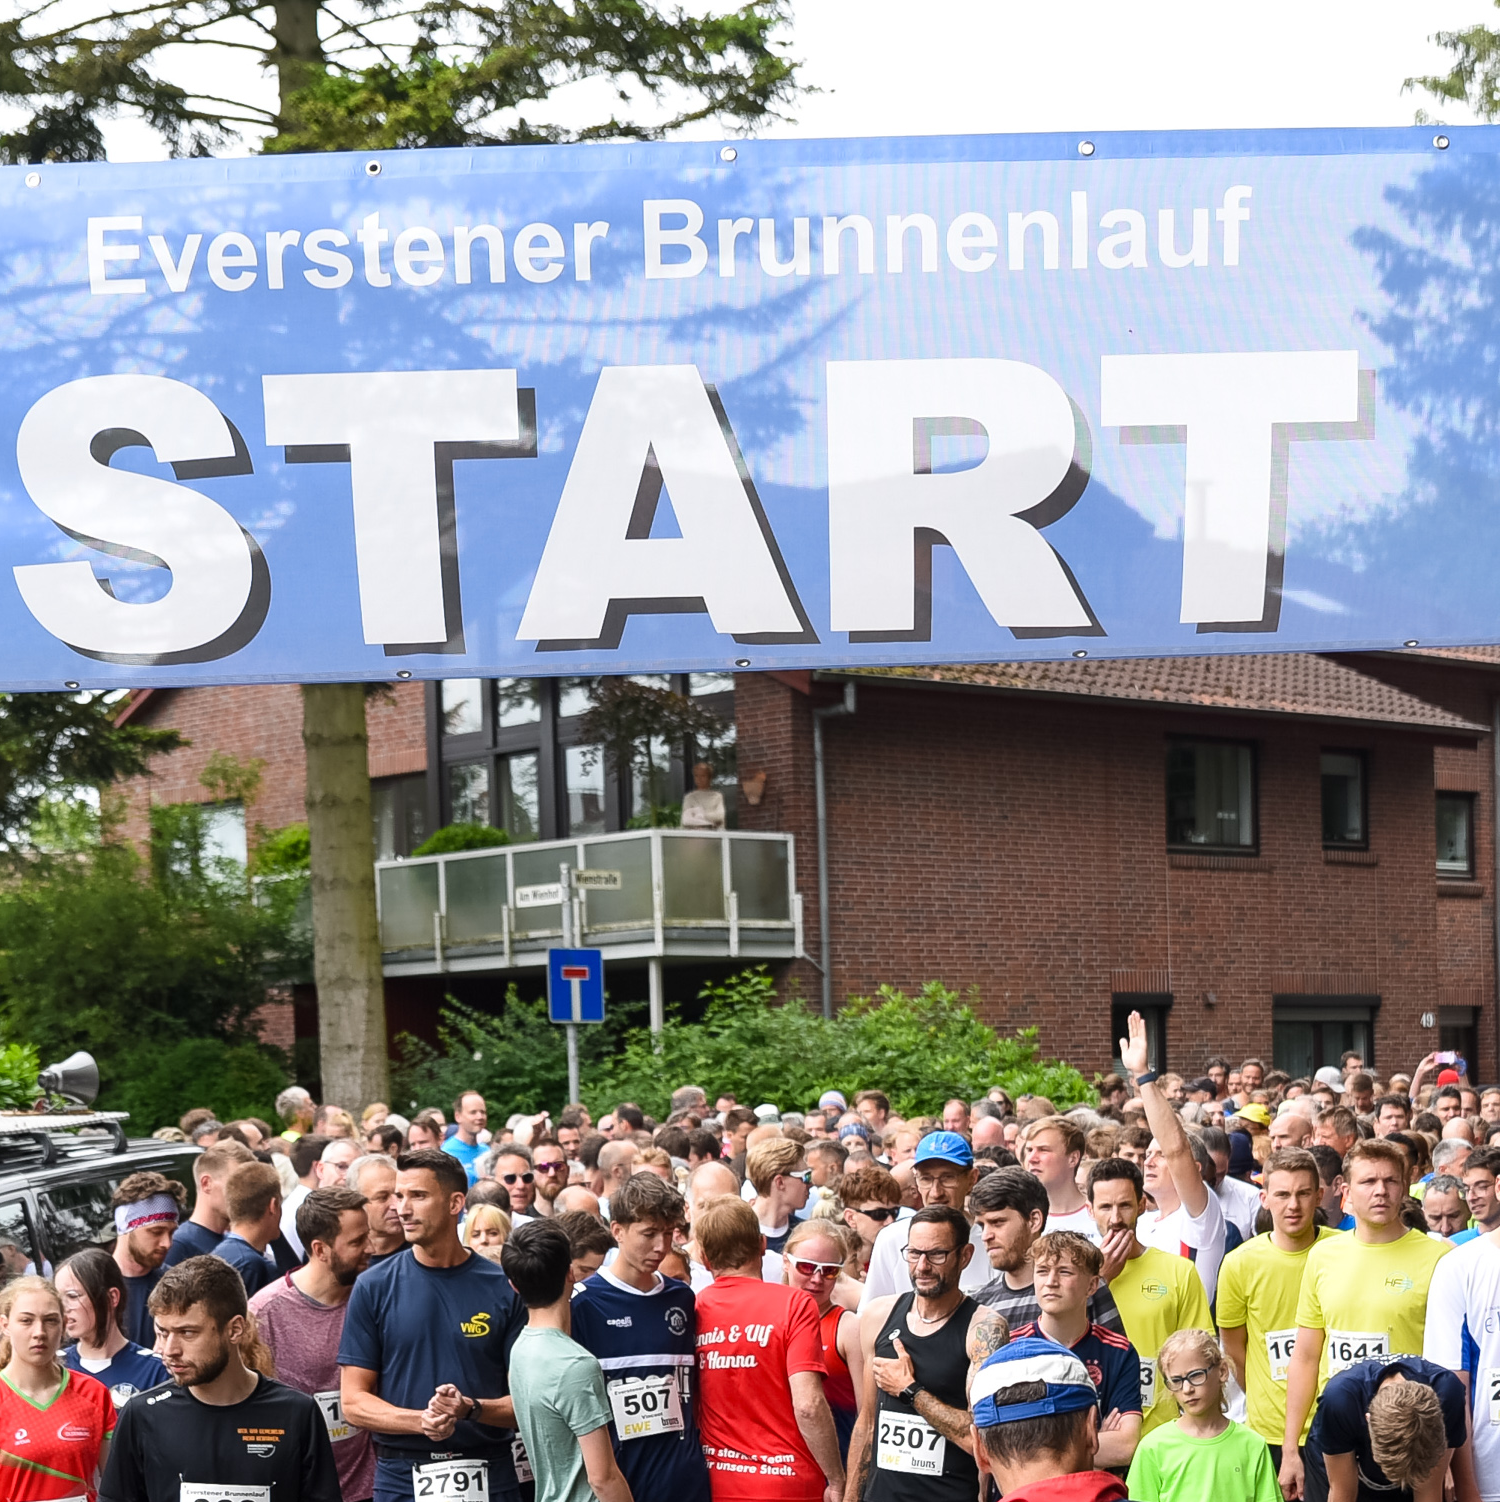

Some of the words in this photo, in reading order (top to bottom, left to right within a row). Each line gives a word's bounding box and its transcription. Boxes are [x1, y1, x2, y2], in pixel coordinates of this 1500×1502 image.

[86, 210, 610, 296] Everstener
[641, 184, 1254, 280] Brunnenlauf
[11, 349, 1373, 666] START
[1420, 1011, 1435, 1028] 49
[460, 1321, 483, 1335] VWG
[728, 1324, 743, 1343] &
[744, 1323, 774, 1347] Ulf
[706, 1350, 758, 1370] Hanna
[624, 1388, 671, 1416] 507
[624, 1421, 651, 1435] EWE
[880, 1423, 943, 1452] 2507
[716, 1462, 757, 1475] unsere
[759, 1463, 796, 1477] Stadt.
[911, 1456, 936, 1469] bruns
[417, 1470, 484, 1497] 2791
